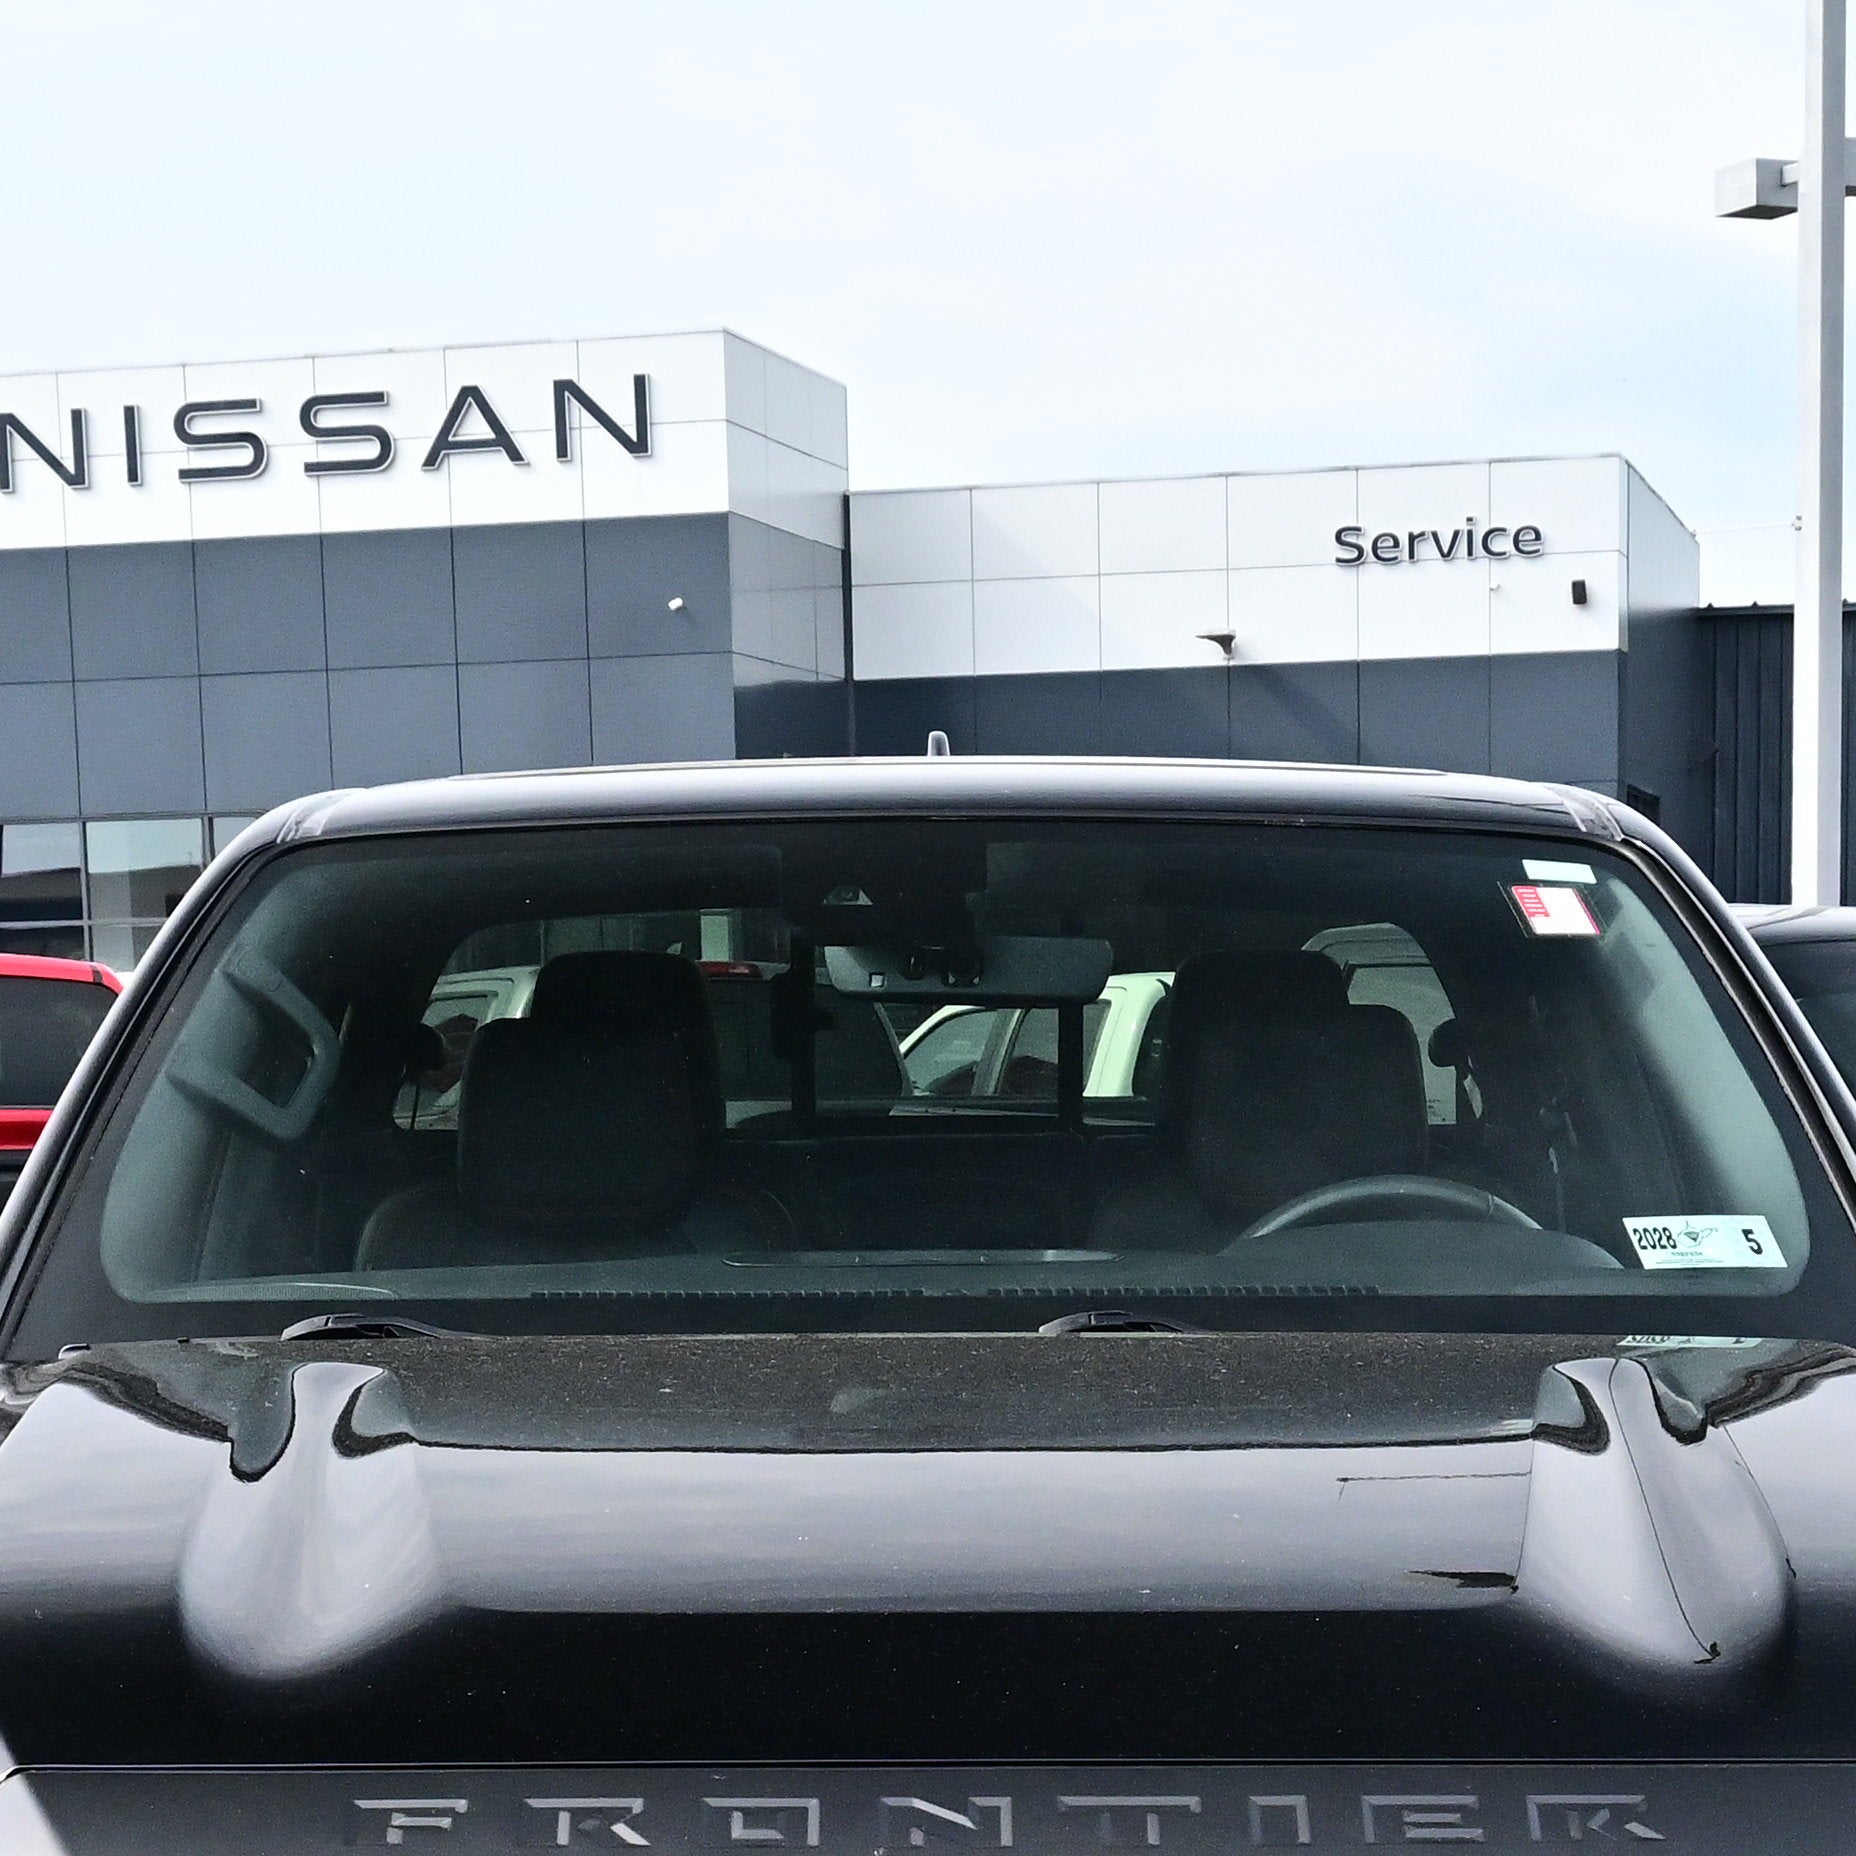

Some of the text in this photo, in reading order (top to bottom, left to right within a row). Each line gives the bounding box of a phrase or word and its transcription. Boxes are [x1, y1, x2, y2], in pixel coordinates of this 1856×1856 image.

[1333, 517, 1544, 567] Service
[1632, 1226, 1764, 1256] 2028 5
[351, 1795, 1666, 1848] FRONTIER
